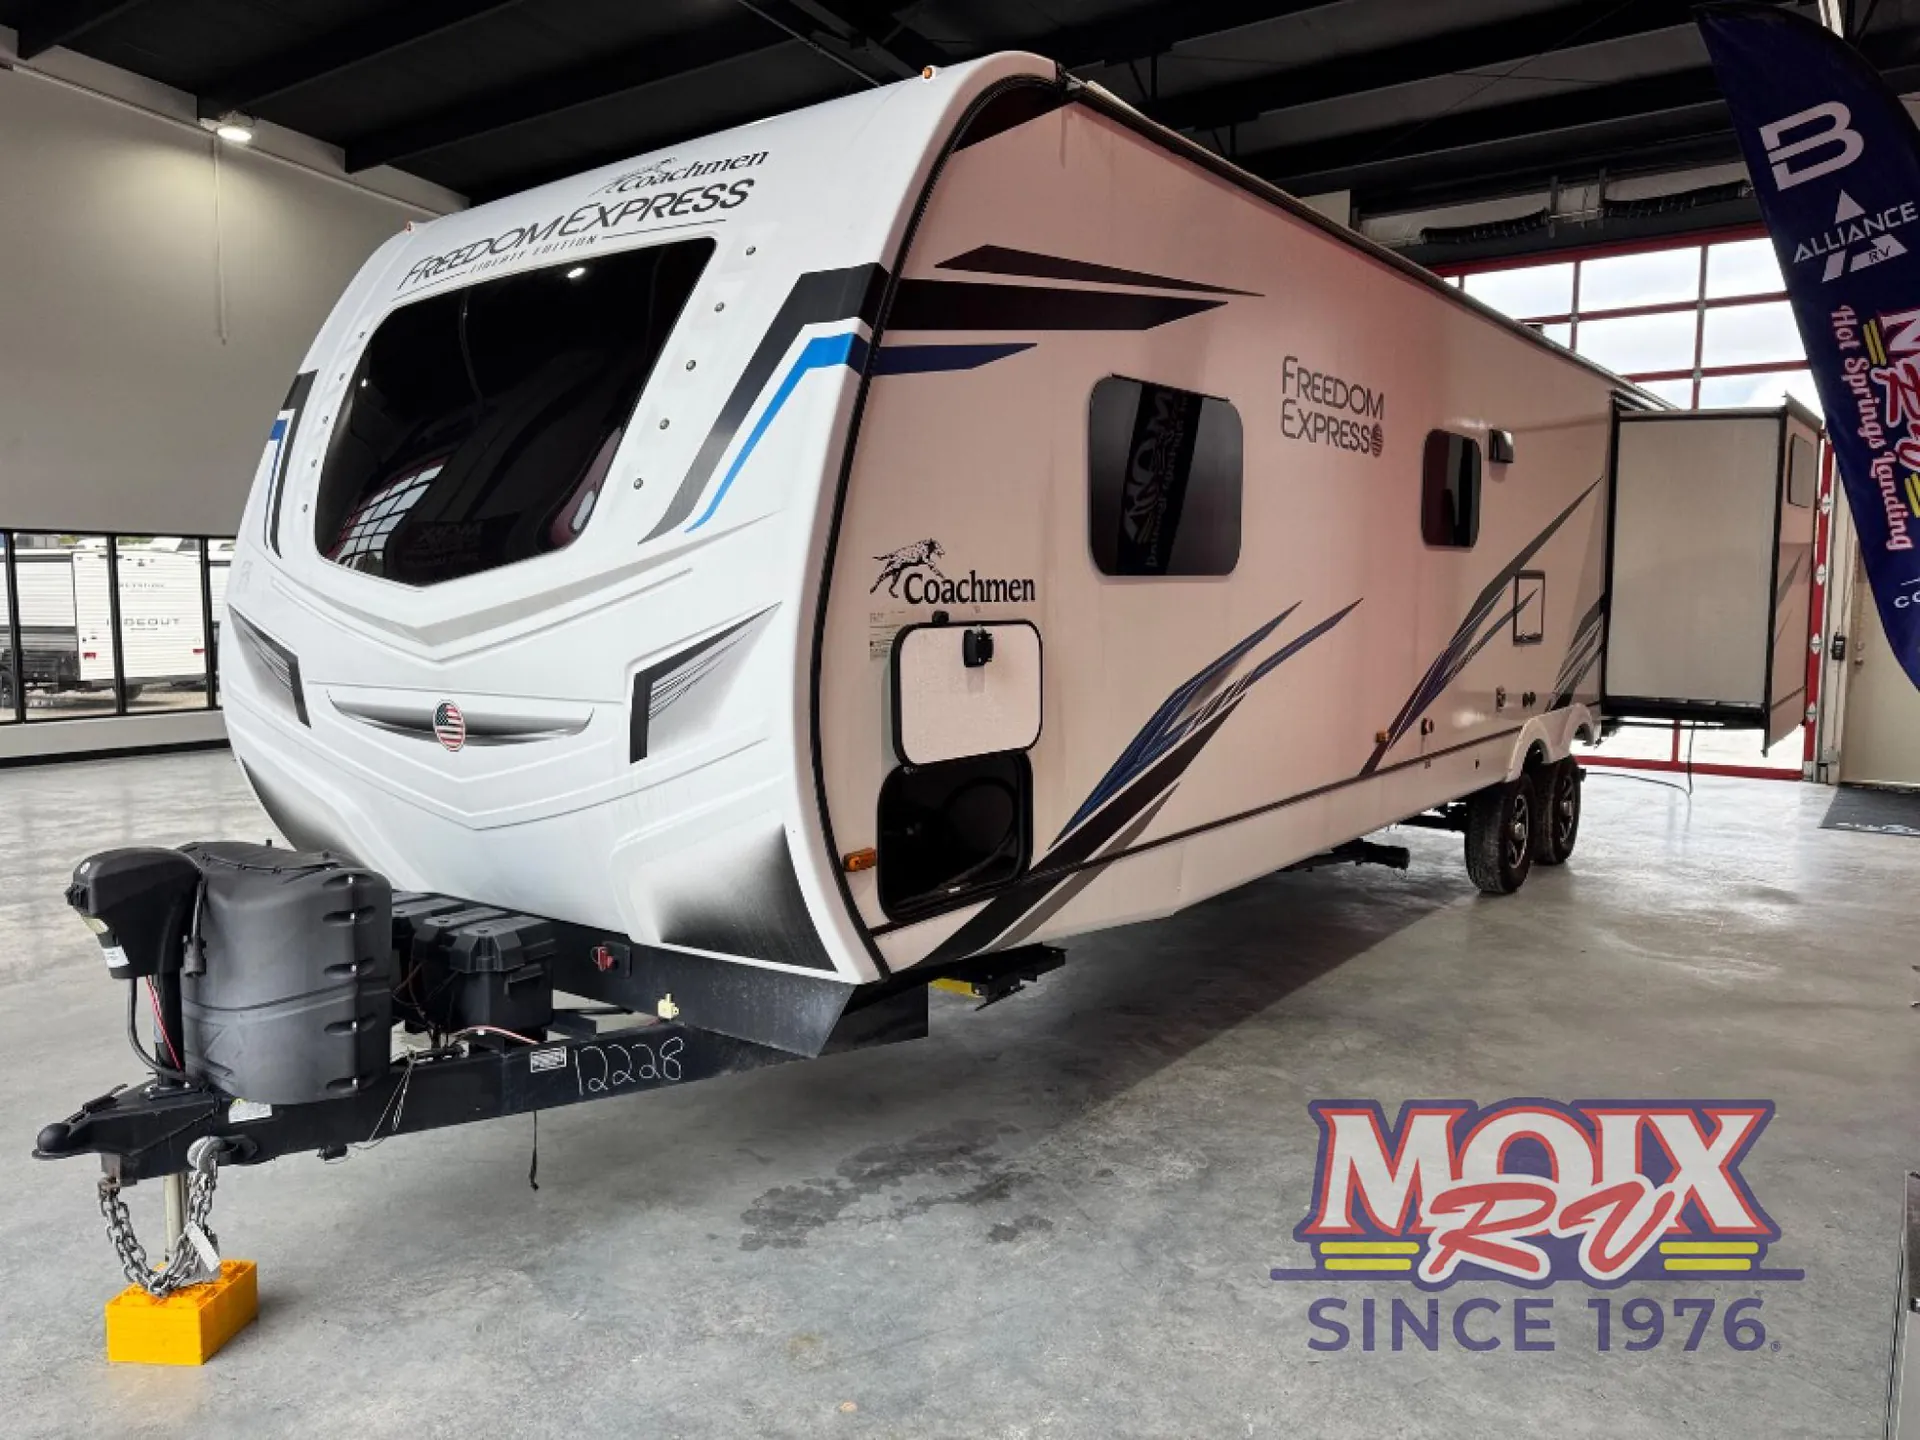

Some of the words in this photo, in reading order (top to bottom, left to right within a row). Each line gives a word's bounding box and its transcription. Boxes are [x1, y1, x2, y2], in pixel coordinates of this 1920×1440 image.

[617, 151, 770, 192] Coachmen
[1793, 201, 1919, 263] ALLIANCE
[1868, 245, 1892, 263] RV
[1830, 304, 1860, 350] Hot
[1282, 355, 1384, 420] FREEDOM
[1841, 357, 1887, 449] Springs
[1281, 398, 1370, 454] EXPRESS
[1871, 451, 1914, 550] Landing
[904, 570, 1036, 604] Coachmen
[573, 1036, 685, 1096] 12228
